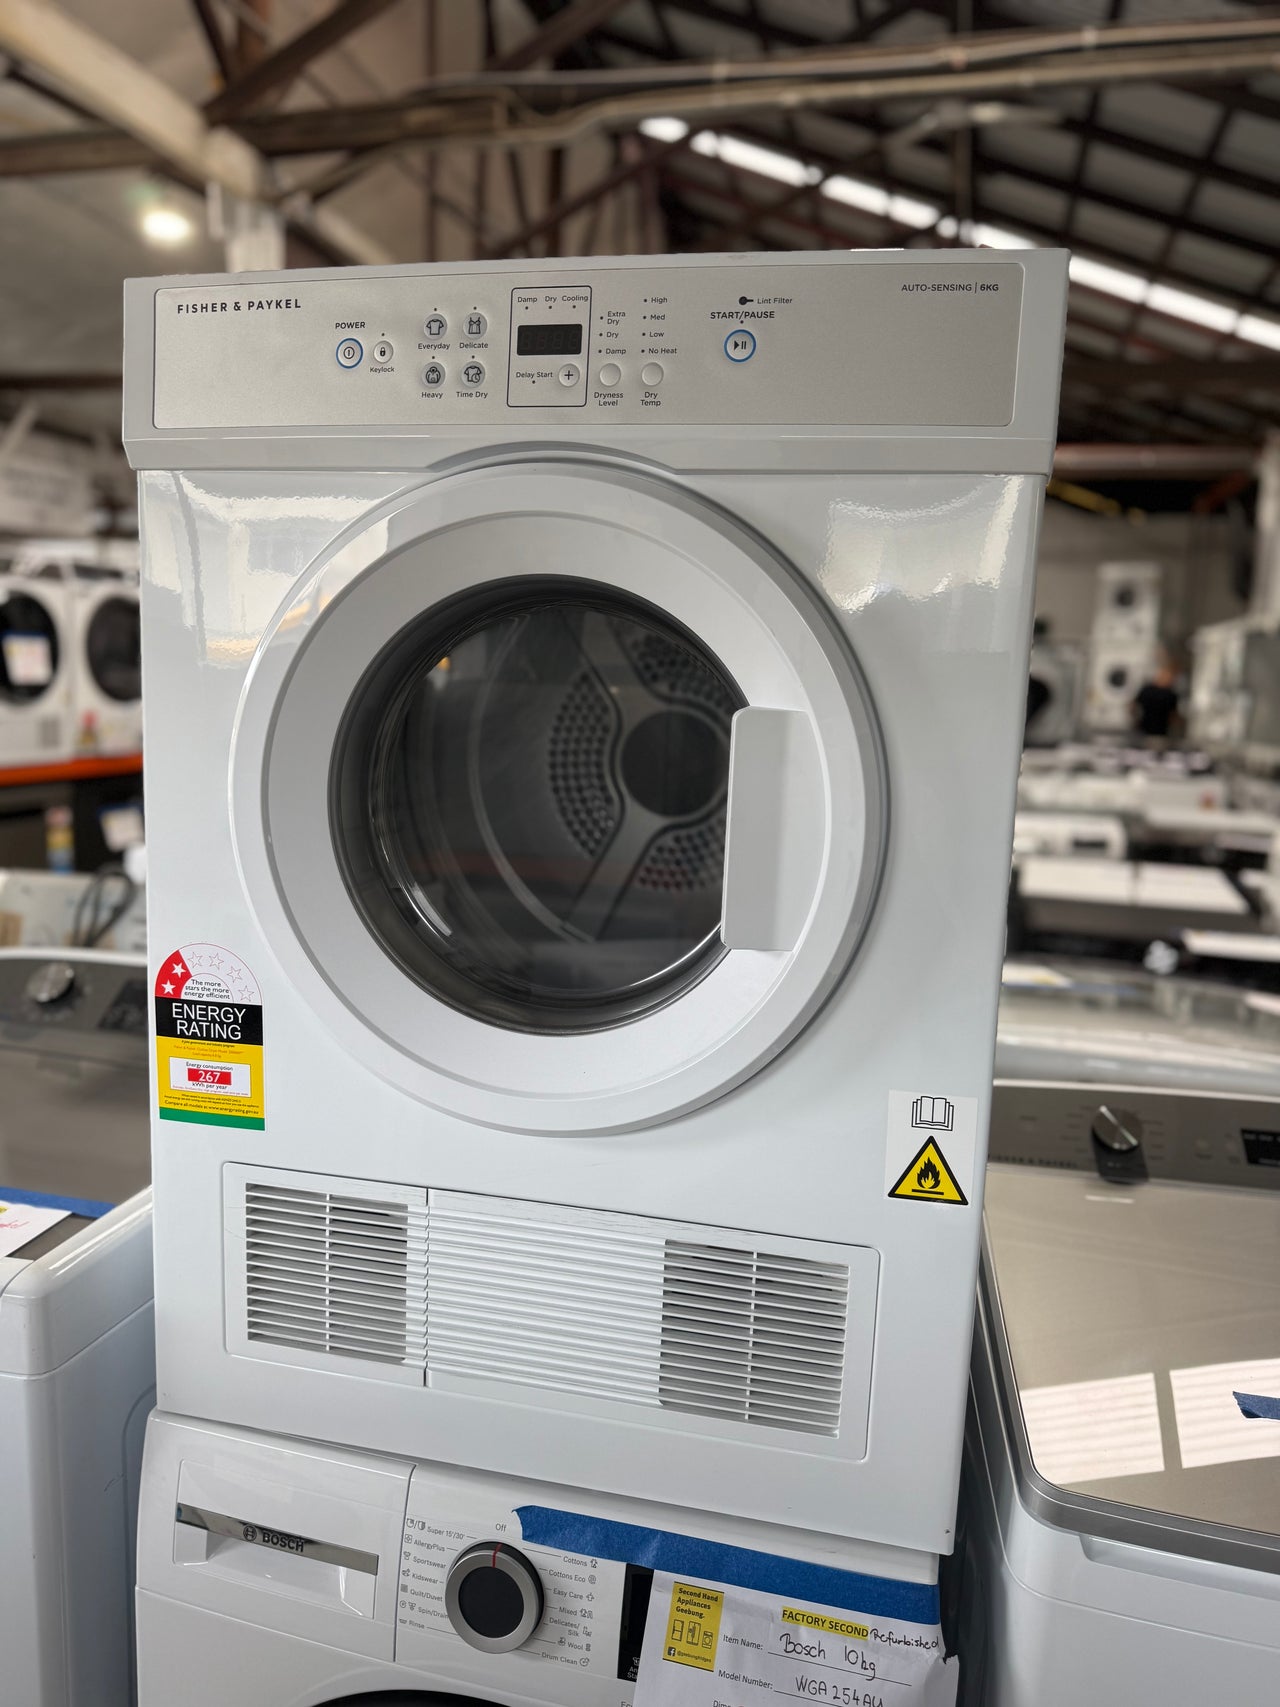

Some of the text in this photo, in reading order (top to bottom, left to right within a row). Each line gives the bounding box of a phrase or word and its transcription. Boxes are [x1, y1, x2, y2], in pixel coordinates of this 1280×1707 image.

[901, 283, 972, 292] AUTO-SENSING
[980, 283, 999, 292] 6KG
[177, 299, 301, 314] FISHER & PAYKEL
[710, 311, 776, 320] START/PAUSE
[417, 342, 450, 350] Everyday
[515, 371, 535, 379] Delay
[421, 391, 444, 399] Heavy
[475, 391, 488, 399] Dry
[644, 391, 658, 399] Dry
[172, 1002, 246, 1024] ENERGY
[176, 1019, 242, 1040] RATING
[186, 1061, 233, 1071] Energy consumption
[198, 1070, 221, 1083] 267
[427, 1526, 445, 1536] Super
[495, 1523, 507, 1533] Off
[262, 1532, 305, 1552] BOSCH
[414, 1539, 446, 1552] AllergyPlus
[413, 1556, 446, 1569] Sportswear
[563, 1556, 587, 1566] Cottons
[412, 1573, 438, 1584] Kidswear
[548, 1569, 586, 1582] Cottons Eco
[410, 1589, 443, 1602] Quilt/Duvet
[553, 1588, 583, 1600] Easy Care
[678, 1587, 719, 1602] Second Hand
[677, 1597, 711, 1610] Appliances
[418, 1606, 449, 1619] Spin/Drain
[559, 1606, 577, 1616] Mixed
[676, 1605, 705, 1619] Geebung.
[408, 1620, 425, 1629] Rinse
[549, 1617, 580, 1629] Delicates/
[782, 1609, 869, 1638] FACTORY SECOND
[567, 1629, 579, 1637] Silk
[567, 1641, 584, 1650] Wool
[722, 1634, 764, 1650] Item Name:
[779, 1633, 826, 1660] Bosch
[541, 1651, 578, 1665] Drum Clean
[718, 1670, 773, 1690] Model Number:
